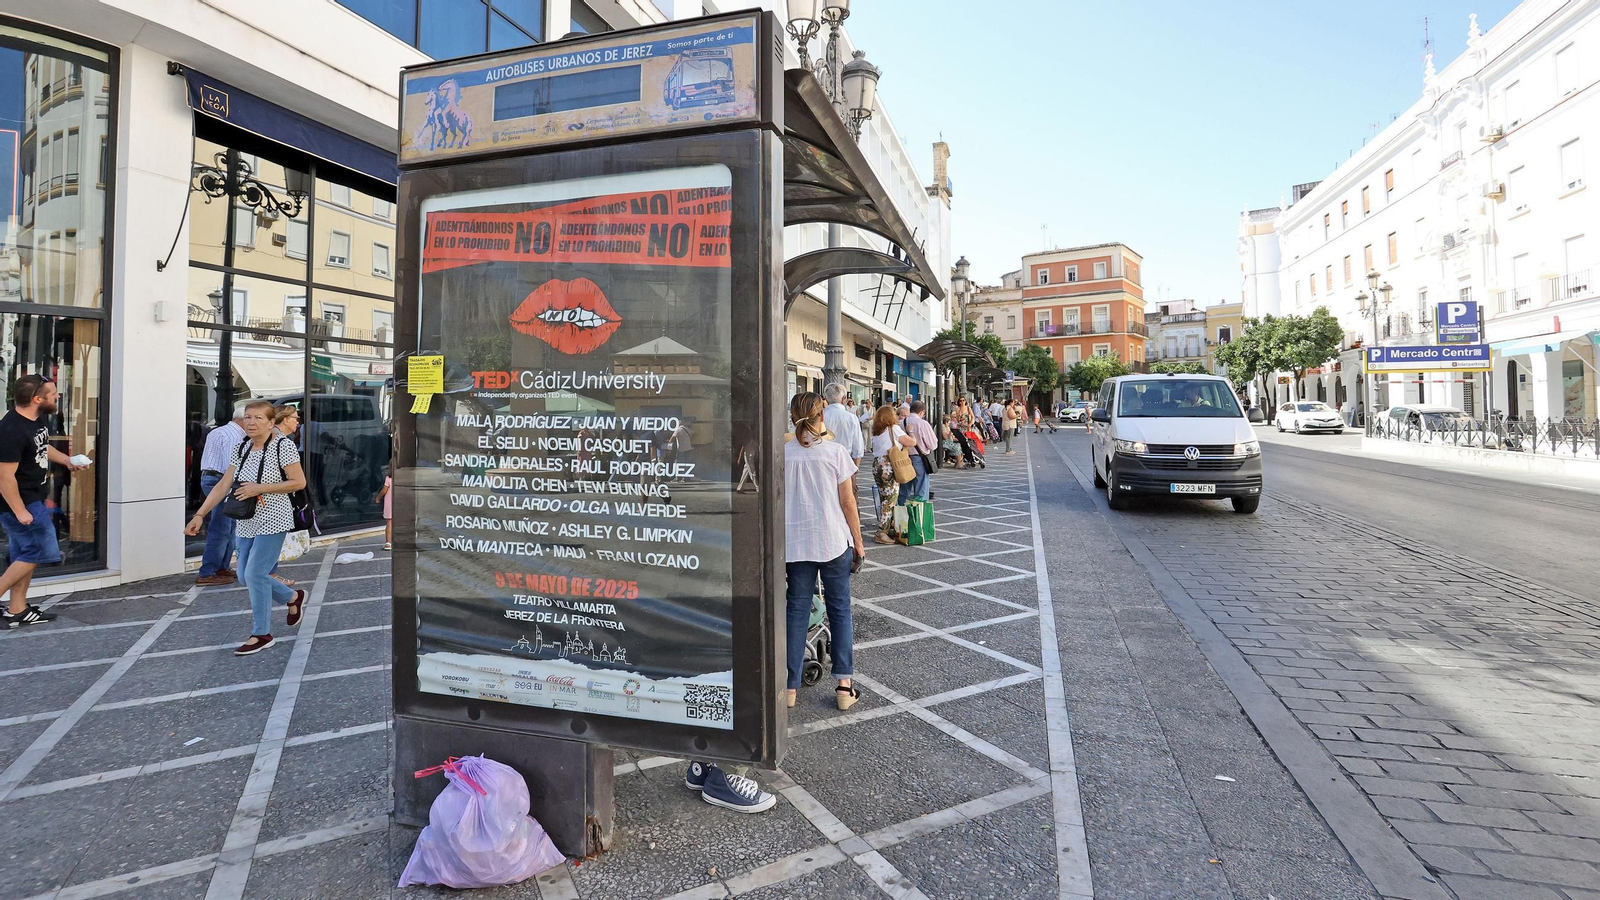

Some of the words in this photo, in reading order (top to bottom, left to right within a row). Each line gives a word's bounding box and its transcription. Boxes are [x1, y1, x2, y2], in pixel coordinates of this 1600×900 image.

[667, 41, 691, 49] Somos
[694, 36, 714, 46] parte
[716, 32, 726, 40] de
[486, 60, 544, 82] AUTOBUSES
[548, 52, 602, 72] URBANOS
[604, 50, 619, 62] DE
[621, 45, 653, 60] JEREZ
[204, 98, 226, 112] VEGA
[209, 94, 220, 103] LA
[630, 193, 668, 215] NO
[435, 219, 514, 234] ADENTRÁNDONOS
[560, 221, 646, 236] ADENTRÁNDONOS
[700, 225, 731, 238] ADEN
[434, 236, 444, 248] EN
[445, 237, 456, 248] LO
[458, 237, 510, 250] PROHIBIDO
[514, 221, 552, 255] NO
[558, 240, 570, 252] EN
[572, 240, 583, 252] LO
[585, 240, 641, 253] PROHIBIDO
[647, 222, 690, 258] NO
[699, 243, 713, 256] EN
[714, 243, 727, 256] LO
[547, 310, 576, 321] NO
[1447, 303, 1467, 324] P
[1372, 349, 1382, 361] P
[1390, 349, 1438, 358] Mercado
[478, 391, 518, 400] independently
[456, 414, 493, 428] MALA
[495, 412, 572, 429] RODRÍGUEZ
[578, 416, 616, 430] JUAN
[620, 417, 632, 430] Y
[633, 417, 680, 432] MEDIO
[478, 436, 493, 449] EL
[496, 436, 528, 450] SELU
[538, 438, 581, 451] NOEMI
[584, 438, 652, 457] CASQUET
[444, 454, 496, 468] SANDRA
[498, 456, 563, 472] MORALES
[570, 456, 606, 474] RAÚL
[609, 458, 696, 478] RODRÍGUEZ
[462, 475, 529, 490] MANOLITA
[531, 478, 568, 492] CHEN
[574, 480, 605, 494] TEW
[608, 482, 670, 498] BUNNAG
[450, 493, 484, 508] DAVID
[487, 495, 562, 512] GALLARDO
[569, 500, 610, 515] OLGA
[614, 502, 687, 518] VALVERDE
[446, 515, 501, 530] ROSARIO
[502, 517, 548, 536] MUÑOZ
[558, 523, 613, 539] ASHLEY
[616, 526, 631, 541] G.
[634, 527, 693, 544] LIMPKIN
[439, 535, 474, 552] DOÑA
[477, 540, 543, 557] MANTECA
[553, 545, 586, 559] MAUI
[596, 549, 636, 564] FRAN
[637, 552, 700, 570] LOZANO
[494, 572, 505, 588] 9
[505, 572, 524, 589] DE
[525, 573, 568, 595] MAYO
[570, 576, 592, 597] DE
[593, 578, 639, 600] 2025
[513, 594, 552, 607] TEATRO
[552, 599, 617, 615] VILLAMARTA
[504, 610, 535, 622] JEREZ
[536, 612, 552, 624] DE
[554, 613, 568, 624] LA
[571, 614, 626, 632] FRONTERA
[559, 686, 576, 694] MAR
